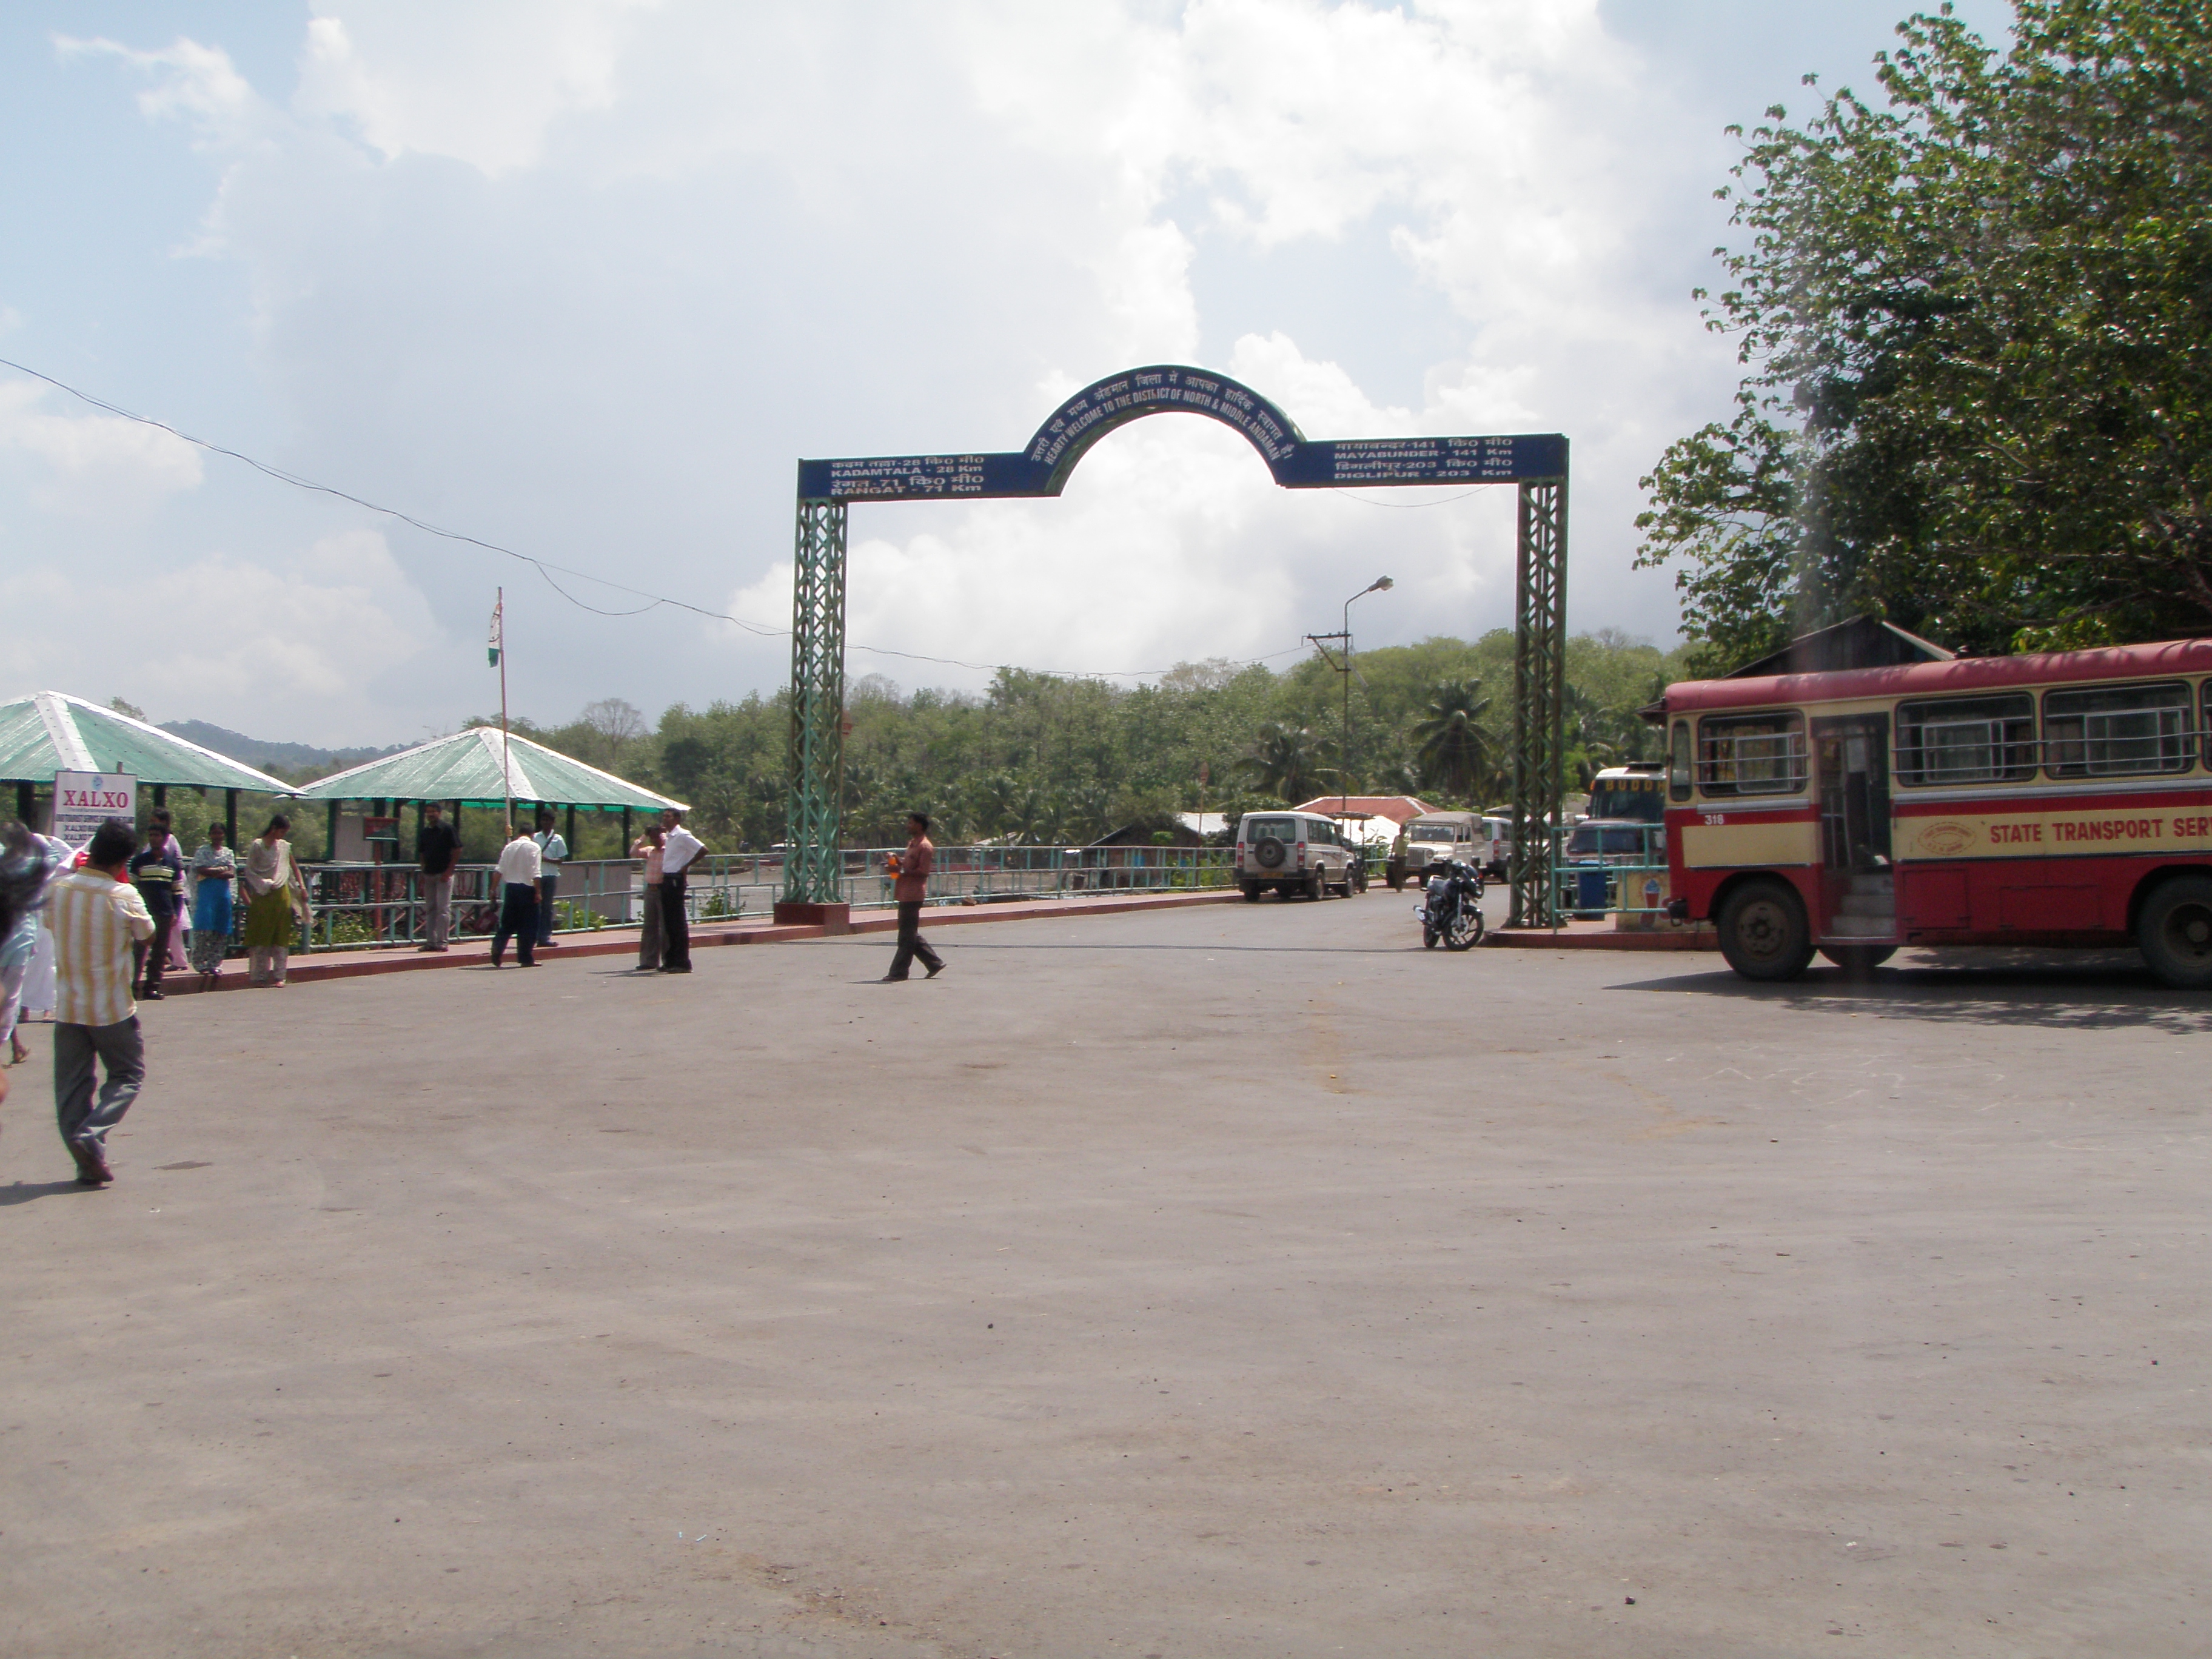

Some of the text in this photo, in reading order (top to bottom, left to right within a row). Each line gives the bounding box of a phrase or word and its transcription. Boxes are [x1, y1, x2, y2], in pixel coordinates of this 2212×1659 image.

[1185, 376, 1219, 393] आपका
[1044, 434, 1068, 465] HEARTY
[1065, 406, 1104, 437] WELCOME
[1102, 400, 1114, 413] TO
[1114, 394, 1132, 408] THE
[1170, 388, 1182, 400] OF
[1183, 390, 1212, 407] NORTH
[1212, 398, 1220, 410] &
[1219, 401, 1252, 426] MIDDLE
[1247, 421, 1281, 460] ANDAMAN
[831, 467, 922, 477] KADAMTALA
[831, 486, 906, 495] RANGAT
[63, 789, 129, 808] XALXO
[1704, 814, 1724, 825] 318
[1990, 823, 2042, 843] STATE
[2052, 819, 2163, 842] TRANSPORT
[2173, 816, 2212, 837] SER
